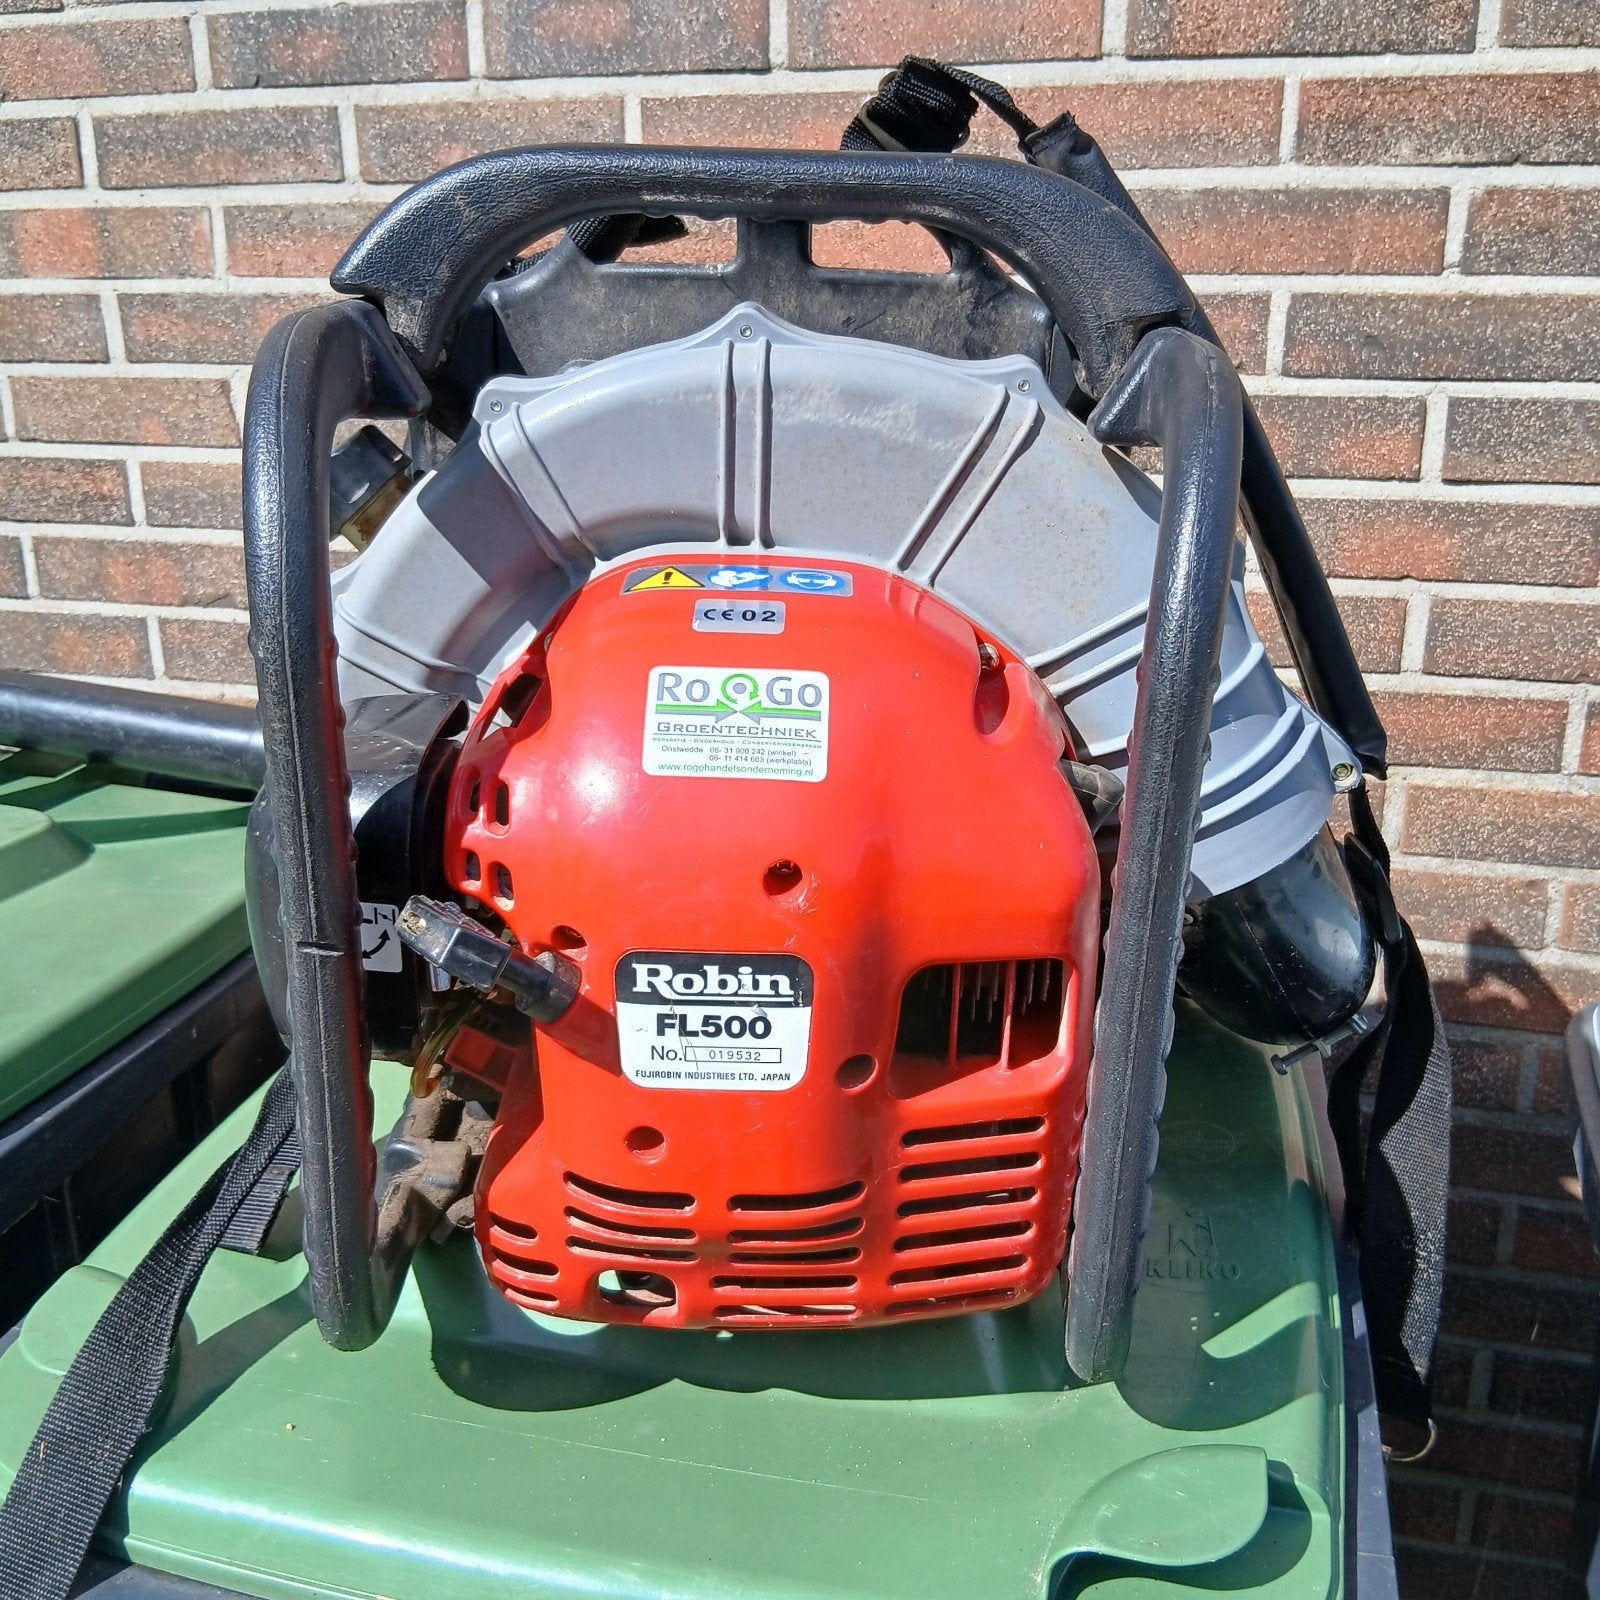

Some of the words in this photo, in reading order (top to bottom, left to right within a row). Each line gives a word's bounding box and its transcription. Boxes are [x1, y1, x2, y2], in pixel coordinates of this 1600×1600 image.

[741, 609, 777, 622] 02
[657, 722, 817, 739] GROENTECHNIEK
[751, 748, 766, 756] 242
[657, 763, 814, 777] www.rogohandelsonderneming.nl
[631, 962, 795, 1002] Robin
[656, 1013, 772, 1040] FL500
[651, 1045, 683, 1061] No.
[709, 1049, 762, 1061] 019532
[635, 1070, 682, 1079] FUJIROBIN
[684, 1071, 736, 1081] INDUSTRIES
[760, 1073, 791, 1081] JAPAN
[1146, 1258, 1241, 1280] KLIKO
